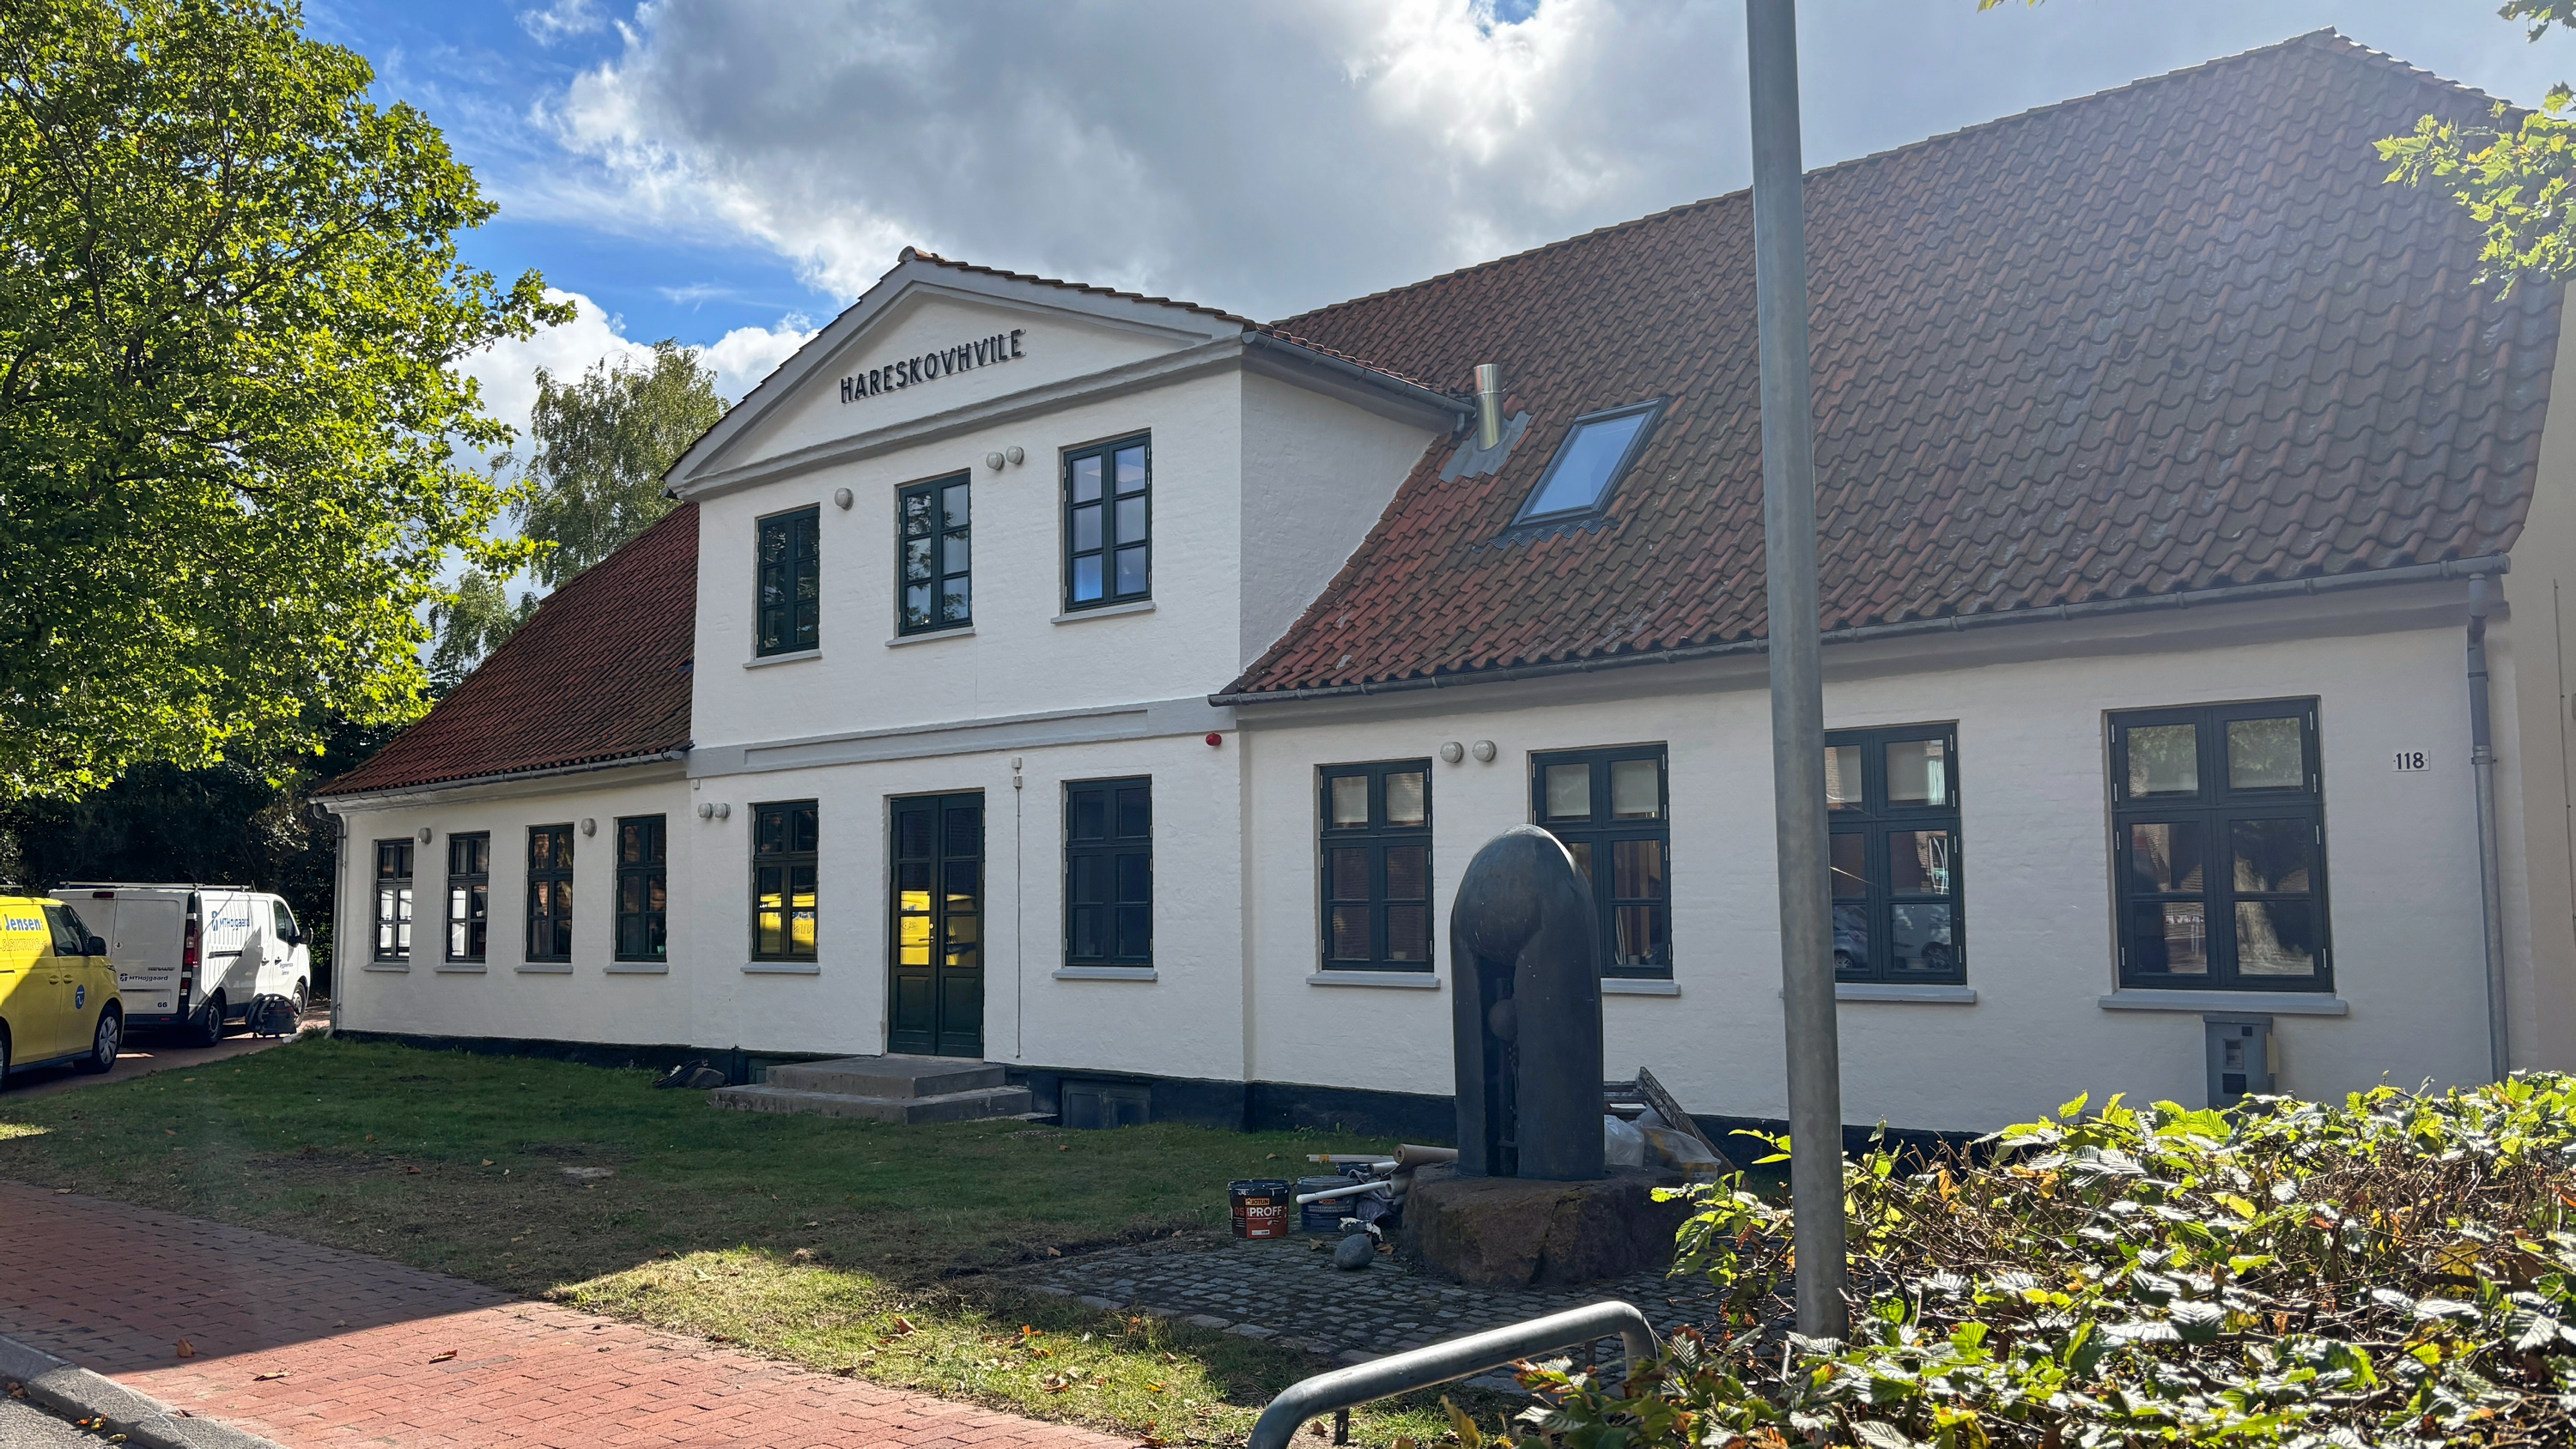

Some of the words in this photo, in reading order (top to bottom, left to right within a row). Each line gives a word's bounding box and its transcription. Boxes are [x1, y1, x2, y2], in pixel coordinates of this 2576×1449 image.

[841, 329, 1022, 403] HARESKOVHVILE
[2396, 751, 2425, 770] 118
[3, 913, 42, 931] Jensen
[1234, 1206, 1245, 1216] 05
[1249, 1205, 1283, 1217] PROFF
